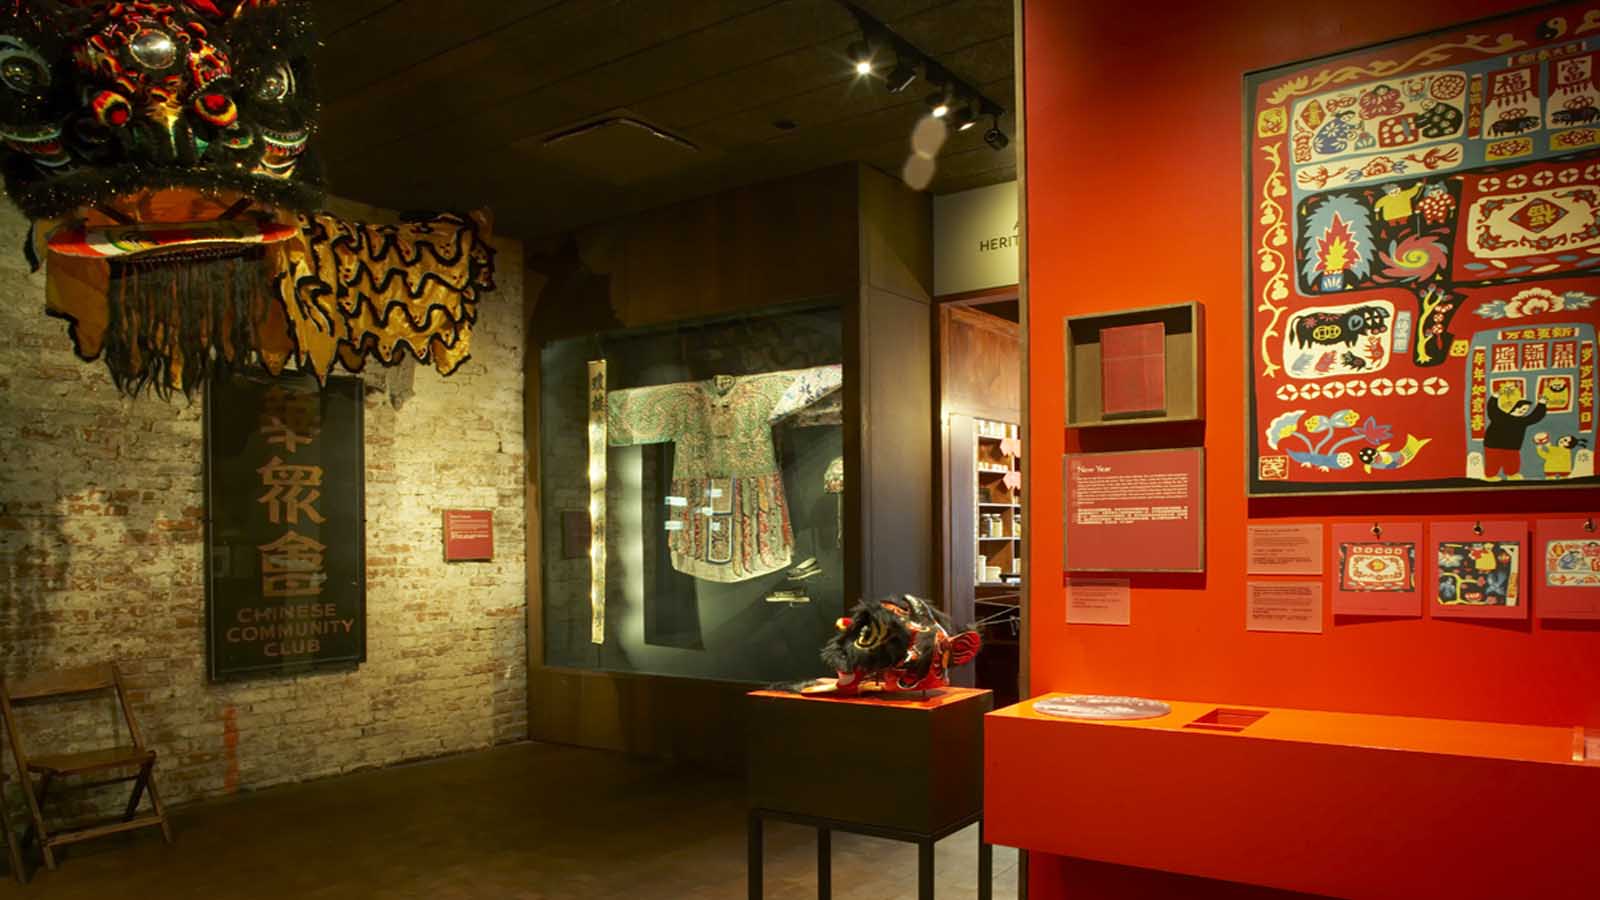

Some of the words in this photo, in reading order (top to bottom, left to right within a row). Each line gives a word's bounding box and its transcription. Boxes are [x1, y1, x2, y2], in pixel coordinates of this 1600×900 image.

[236, 603, 336, 623] CHINESE
[226, 619, 354, 643] COMMUNITY
[263, 639, 321, 657] CLUB
